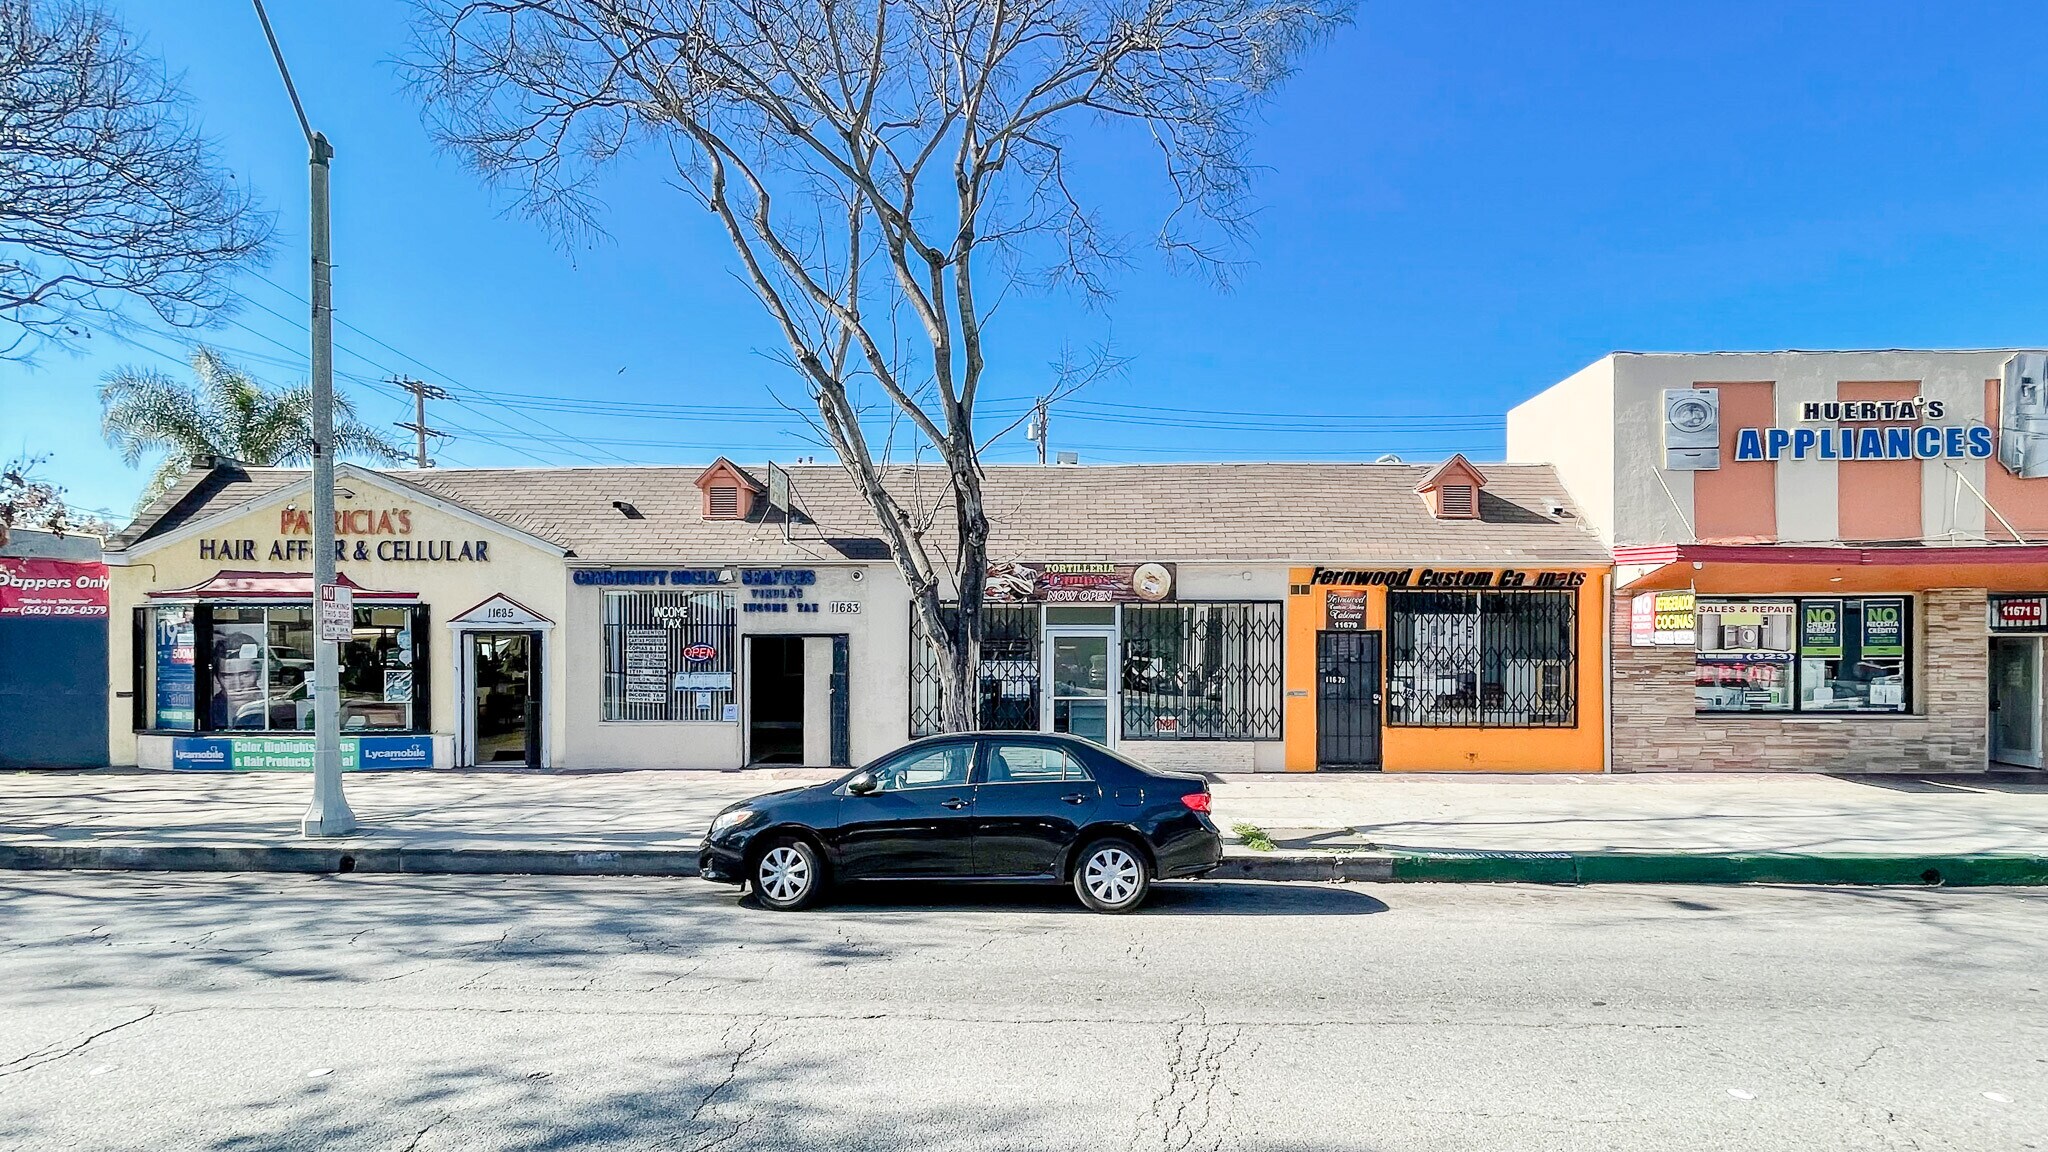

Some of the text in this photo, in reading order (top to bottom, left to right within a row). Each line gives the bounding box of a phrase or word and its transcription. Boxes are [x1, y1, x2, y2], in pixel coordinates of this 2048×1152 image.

[1802, 397, 1945, 422] HUERTA'S
[1735, 426, 1994, 461] APPLIANCES
[281, 507, 412, 535] PARICIA'S
[199, 539, 490, 562] HAIR AFFR & CELLULAR
[1044, 564, 1116, 573] TORTILLERIA
[573, 570, 816, 585] COMMUNITY SOCIA SERVICES
[1311, 567, 1413, 585] Fernwood
[1417, 569, 1493, 586] Custom
[76, 575, 111, 591] Only
[323, 586, 334, 600] NO
[1047, 590, 1113, 601] NOW OPEN
[324, 602, 350, 610] PARKING
[743, 603, 819, 613] INCOME TAX
[830, 602, 859, 613] 11683
[1633, 595, 1652, 614] NO
[20, 605, 51, 616] (562)
[54, 605, 107, 615] 326-0579
[487, 608, 514, 618] 11685
[653, 607, 687, 617] INCOME
[1807, 609, 1836, 622] NO
[1868, 608, 1897, 622] NO
[2002, 606, 2040, 616] 11671 B
[662, 619, 681, 628] TAX
[1655, 614, 1695, 629] COCINAS
[684, 647, 714, 658] OPEN
[1747, 653, 1795, 662] (323)
[1325, 676, 1346, 684] 11679
[234, 741, 315, 754] Color, Highlights
[175, 750, 224, 760] Lycamobile
[365, 748, 426, 760] Lycamobile
[243, 756, 265, 767] Hair
[265, 756, 311, 767] Products
